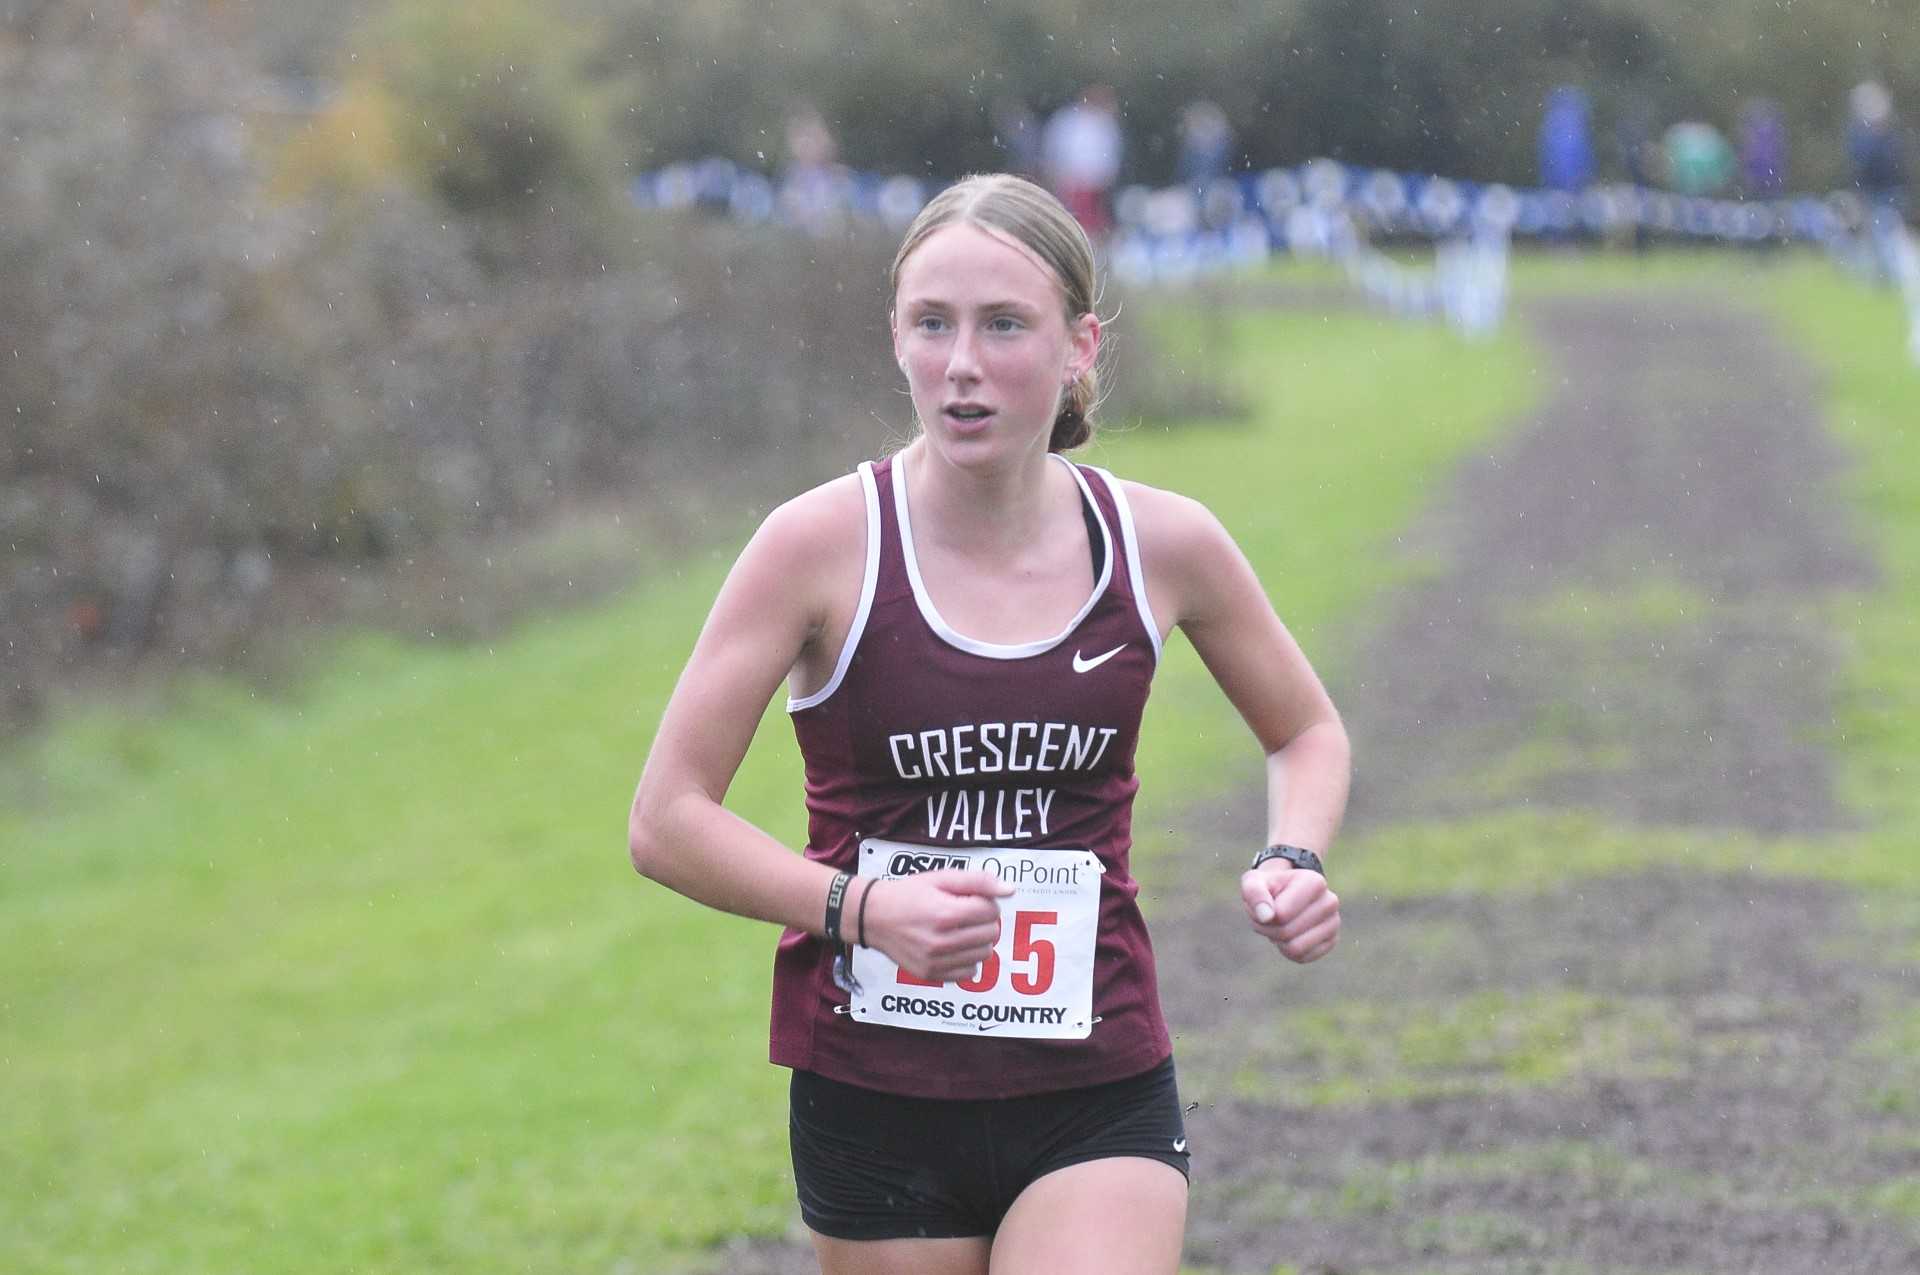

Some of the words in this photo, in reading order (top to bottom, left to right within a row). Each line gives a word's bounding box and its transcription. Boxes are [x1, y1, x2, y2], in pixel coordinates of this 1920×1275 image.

[889, 722, 1118, 779] CRESCENT
[927, 788, 1056, 841] VALLEY
[982, 857, 1079, 885] OnPoint
[881, 994, 955, 1018] CROSS
[961, 1003, 1067, 1024] COUNTRY
